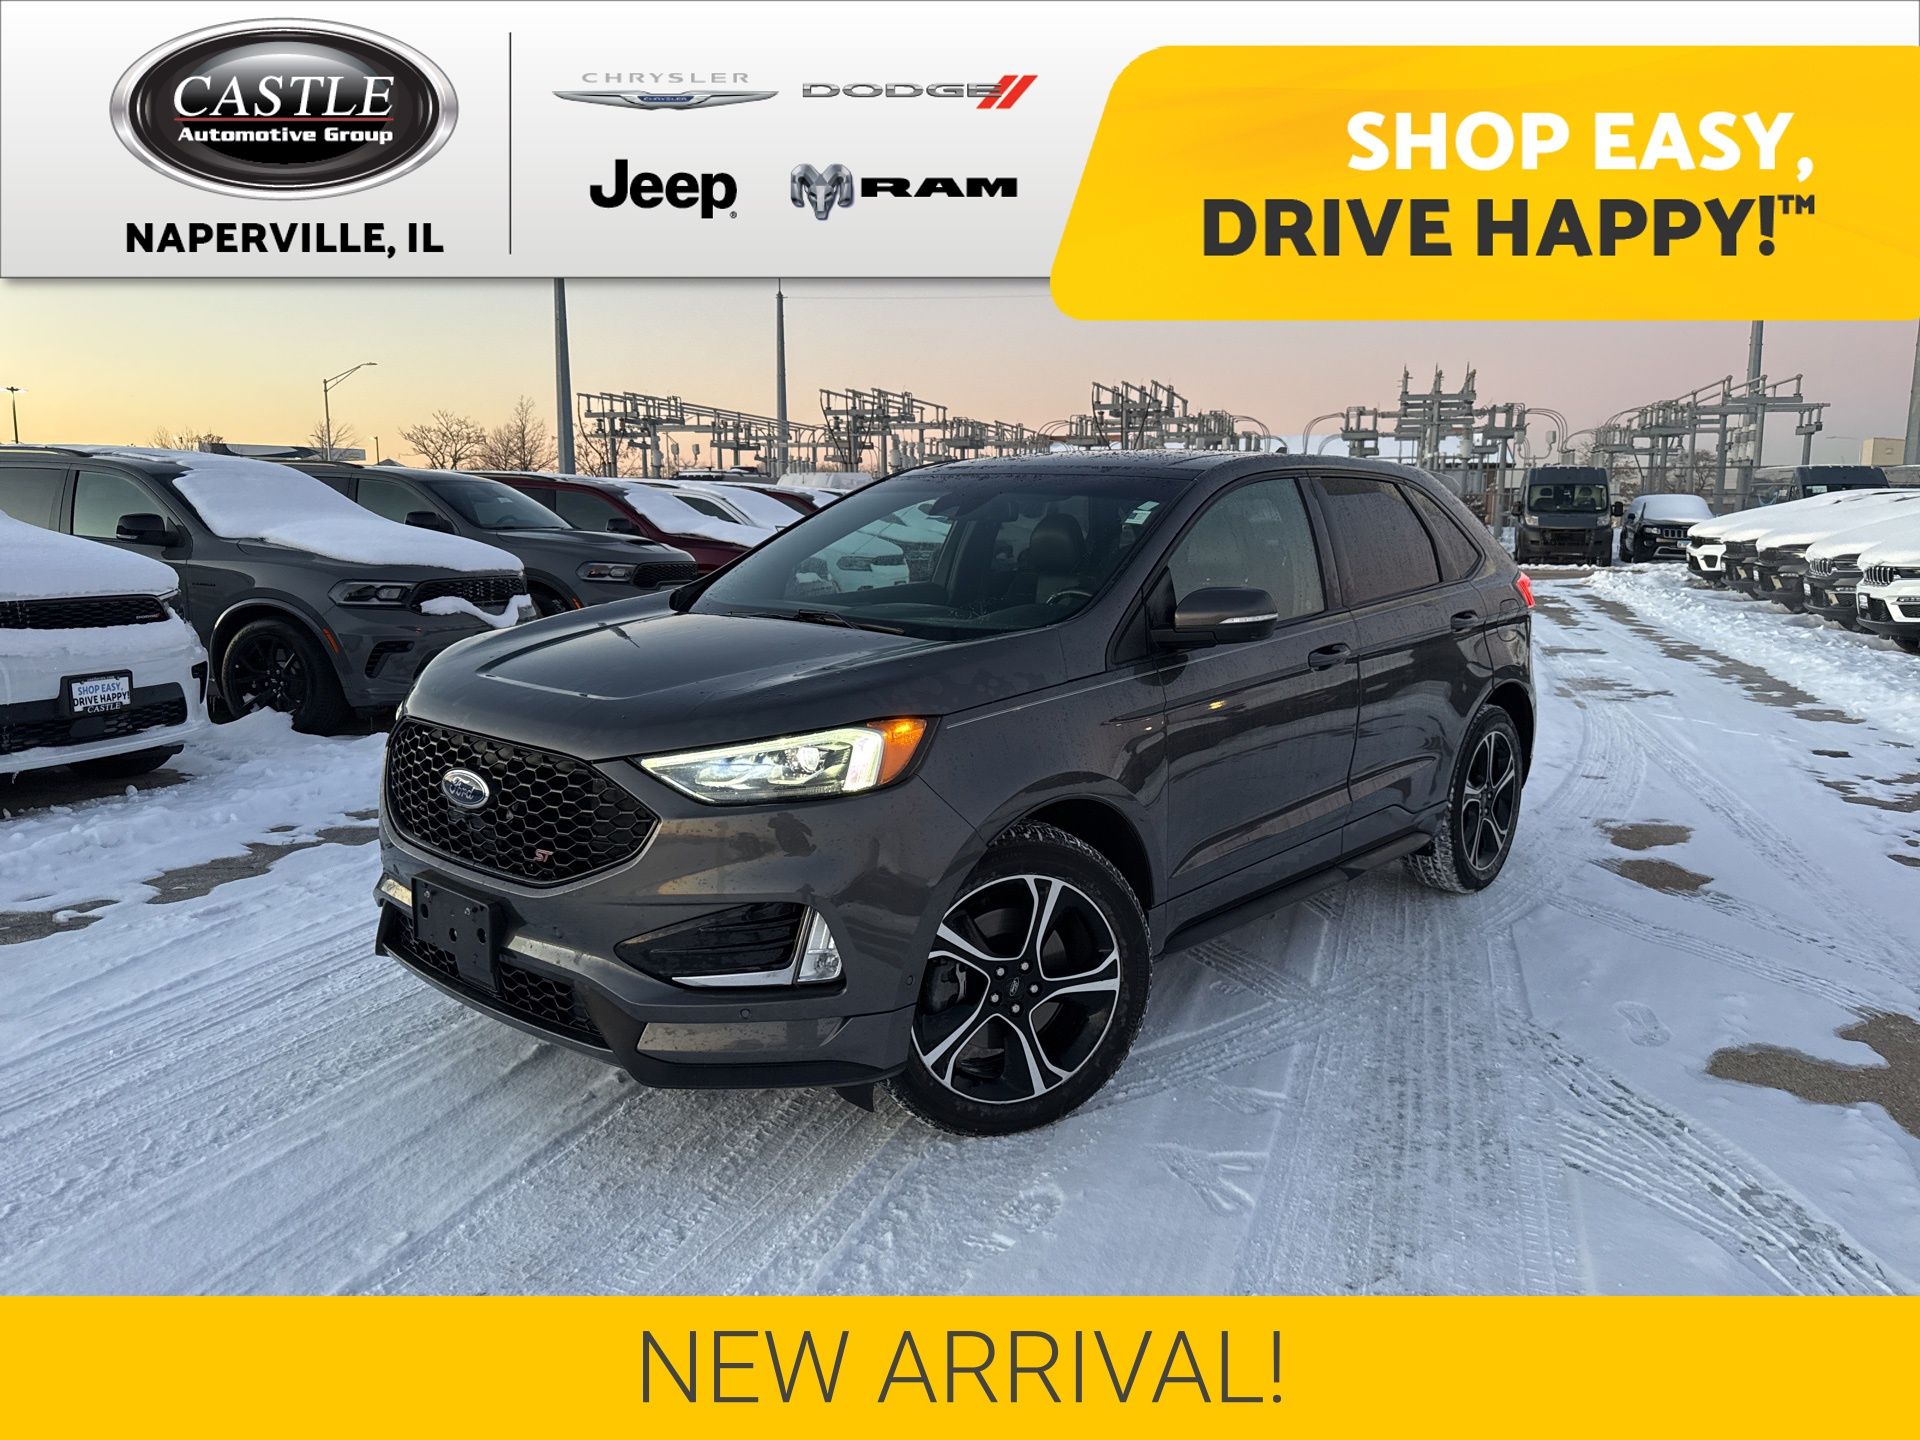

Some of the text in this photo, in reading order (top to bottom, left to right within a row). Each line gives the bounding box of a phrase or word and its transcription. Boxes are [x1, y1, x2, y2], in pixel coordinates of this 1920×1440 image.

[78, 682, 124, 696] SHOP EASY,
[73, 691, 130, 707] DRIVE HAPPY!
[87, 702, 121, 714] CASTLE
[449, 776, 477, 800] Ford
[533, 848, 554, 863] ST
